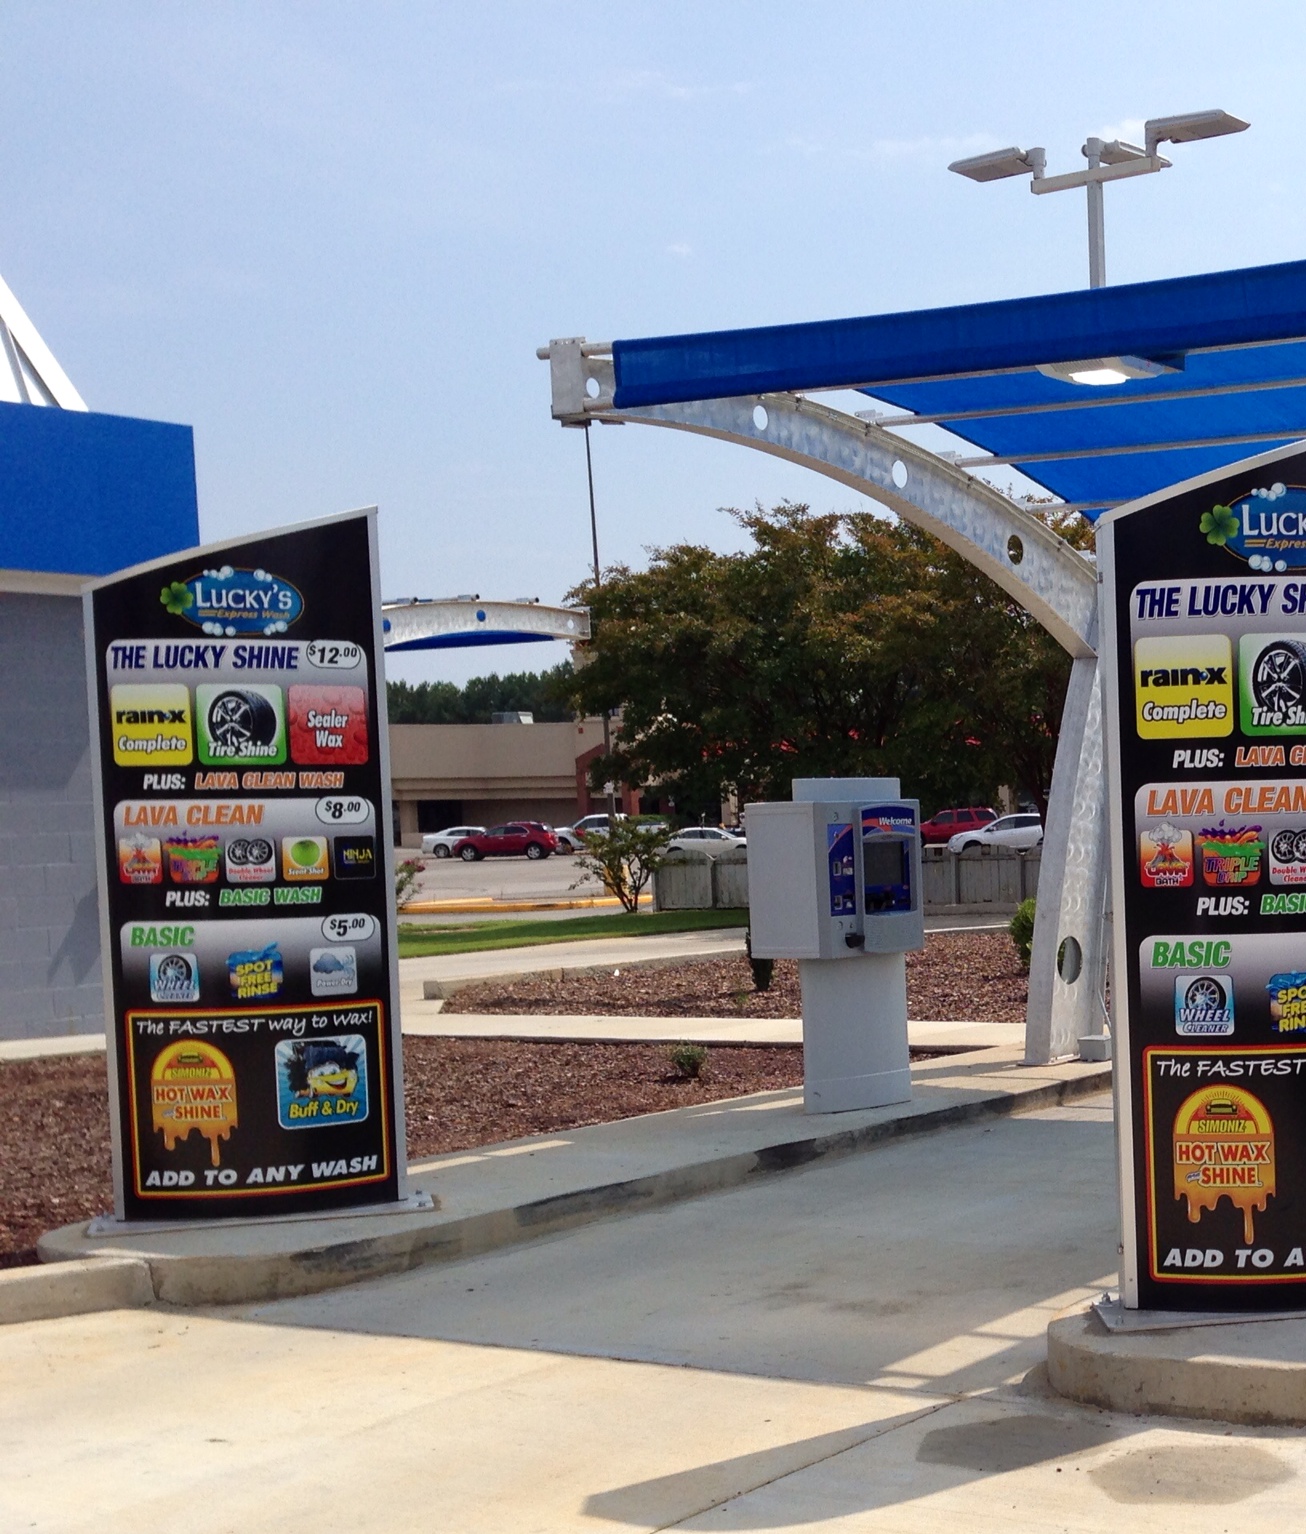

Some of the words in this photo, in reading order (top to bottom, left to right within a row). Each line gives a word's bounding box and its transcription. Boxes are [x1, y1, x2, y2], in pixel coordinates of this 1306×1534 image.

[1136, 587, 1180, 619] THE
[1188, 584, 1275, 616] LUCKY
[217, 609, 258, 620] Express
[262, 610, 290, 620] Wash
[112, 645, 146, 669] THE
[153, 645, 229, 669] LUCKY
[233, 646, 299, 669] SHINE
[309, 644, 357, 664] $12.00
[308, 710, 347, 729] Sealer
[1142, 699, 1226, 725] Complete
[1252, 706, 1284, 726] Tire
[118, 735, 186, 754] Complete
[316, 731, 342, 748] Wax
[208, 742, 237, 757] Tire
[239, 742, 277, 758] Shine
[1172, 750, 1224, 769] PLUS:
[1235, 746, 1285, 767] LAVA
[144, 774, 186, 790] PLUS:
[195, 773, 238, 790] LAVA
[242, 772, 295, 789] CLEAN
[299, 772, 344, 788] WASH
[325, 802, 360, 819] $8.00
[1146, 788, 1214, 816] LAVA
[124, 806, 178, 826] LAVA
[186, 805, 263, 825] CLEAN
[879, 816, 912, 826] Welcome
[343, 848, 372, 861] NINJA
[288, 868, 308, 876] Scent
[1206, 857, 1259, 872] TRIPLE
[1272, 865, 1297, 875] Double
[1217, 872, 1247, 884] DRIP
[166, 890, 210, 907] PLUS:
[219, 888, 270, 906] BASIC
[274, 887, 322, 904] WASH
[1197, 897, 1249, 915] PLUS:
[330, 917, 365, 937] $5.00
[130, 926, 195, 947] BASIC
[1151, 941, 1231, 968] BASIC
[236, 960, 274, 976] SPOT
[238, 972, 272, 987] FREE
[238, 982, 277, 998] RINSE
[1180, 1009, 1230, 1022] WHEEL
[137, 1020, 164, 1035] The
[169, 1018, 265, 1034] FASTEST
[268, 1017, 306, 1036] way
[312, 1014, 326, 1028] to
[1182, 1022, 1228, 1033] CLEANER
[1157, 1058, 1190, 1076] The
[156, 1086, 185, 1102] HOT
[189, 1086, 230, 1101] WAX
[175, 1104, 222, 1119] SHINE
[288, 1102, 318, 1120] Buff
[322, 1102, 332, 1116] &
[336, 1099, 358, 1118] Dry
[1198, 1120, 1246, 1133] SIMONIZ
[1178, 1144, 1215, 1162] HOT
[1221, 1144, 1266, 1162] WAX
[146, 1169, 195, 1187] ADD
[204, 1168, 238, 1185] TO
[246, 1164, 304, 1184] ANY
[312, 1154, 378, 1178] WASH
[1201, 1167, 1256, 1184] SHINE
[1163, 1249, 1224, 1268] ADD
[1234, 1249, 1274, 1268] TO
